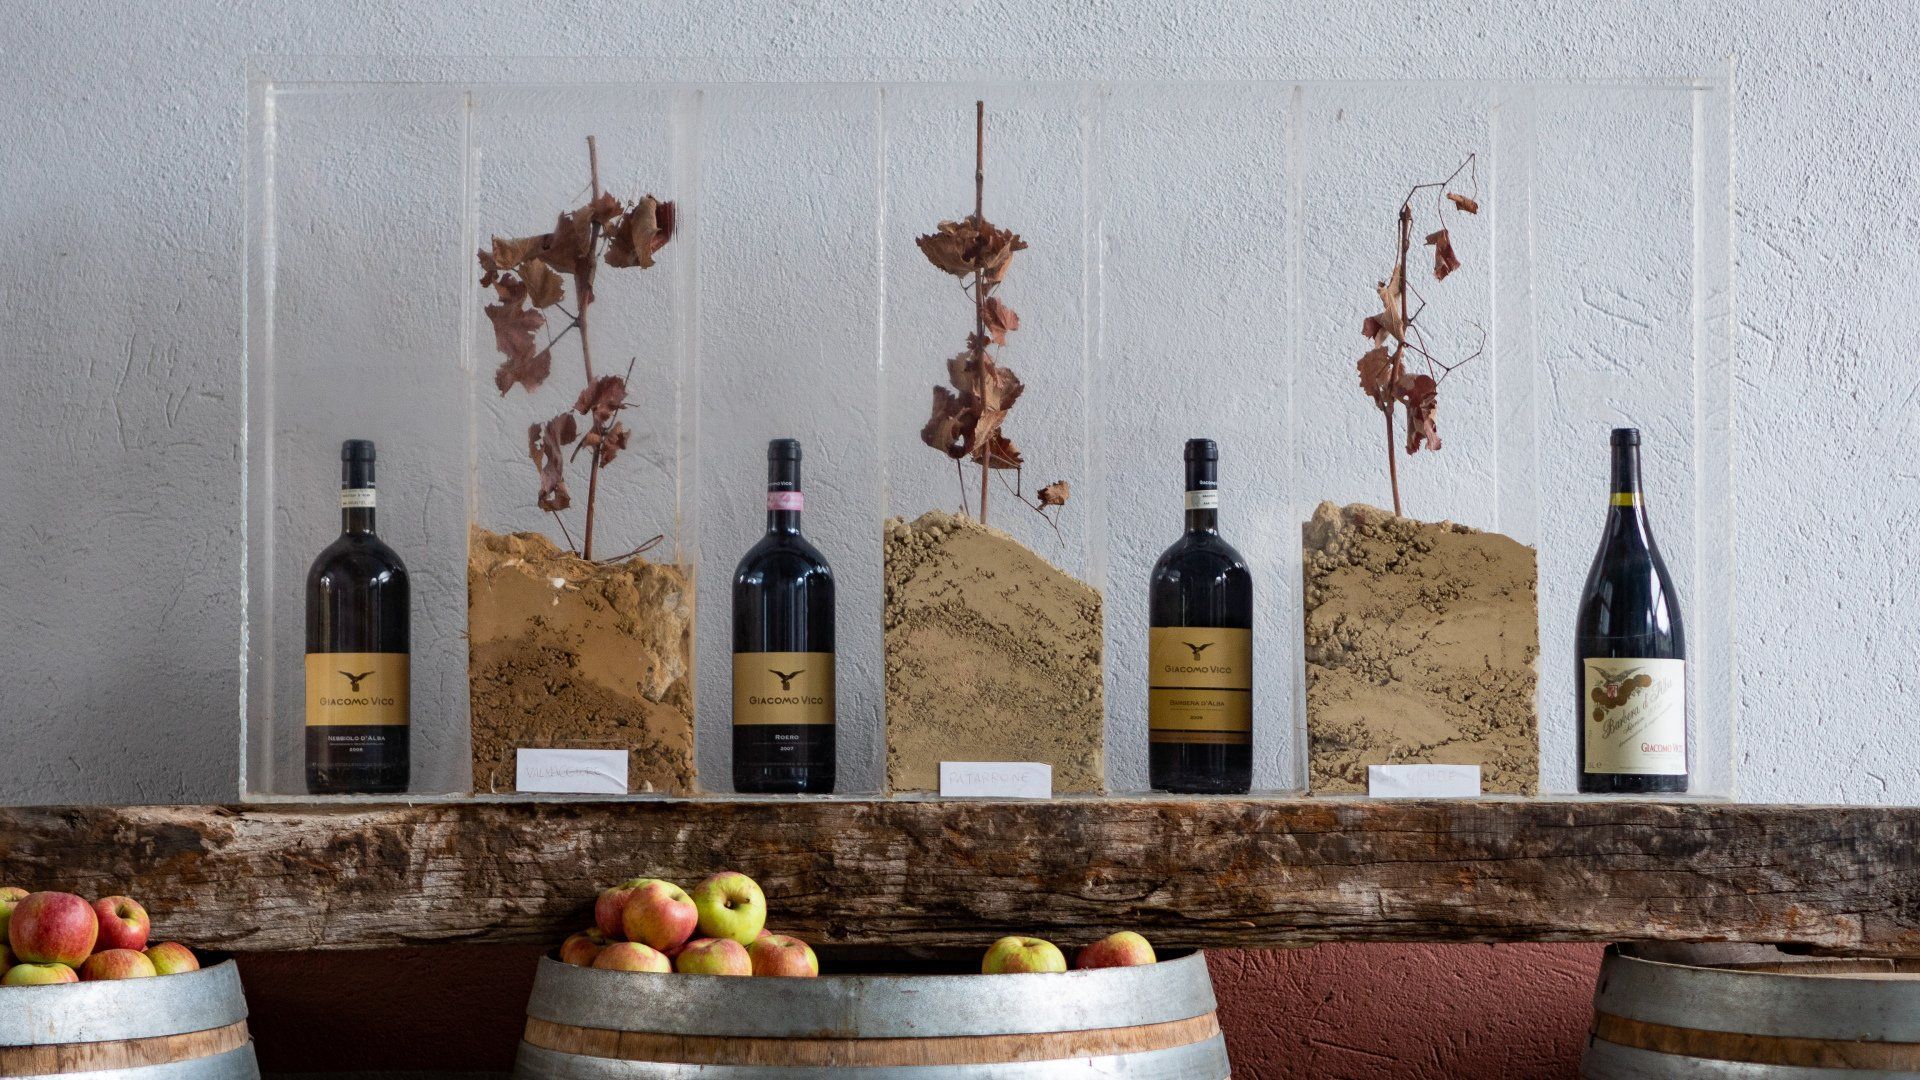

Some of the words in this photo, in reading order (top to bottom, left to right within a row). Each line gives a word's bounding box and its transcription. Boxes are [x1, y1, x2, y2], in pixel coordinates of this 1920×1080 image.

[1165, 665, 1209, 674] GIACOMO
[1210, 665, 1232, 674] VICO
[320, 697, 369, 706] GIACOMO
[370, 697, 395, 706] VICO
[749, 696, 799, 705] GIACOMO
[800, 696, 824, 705] VICO
[1641, 742, 1672, 753] GIACOMO
